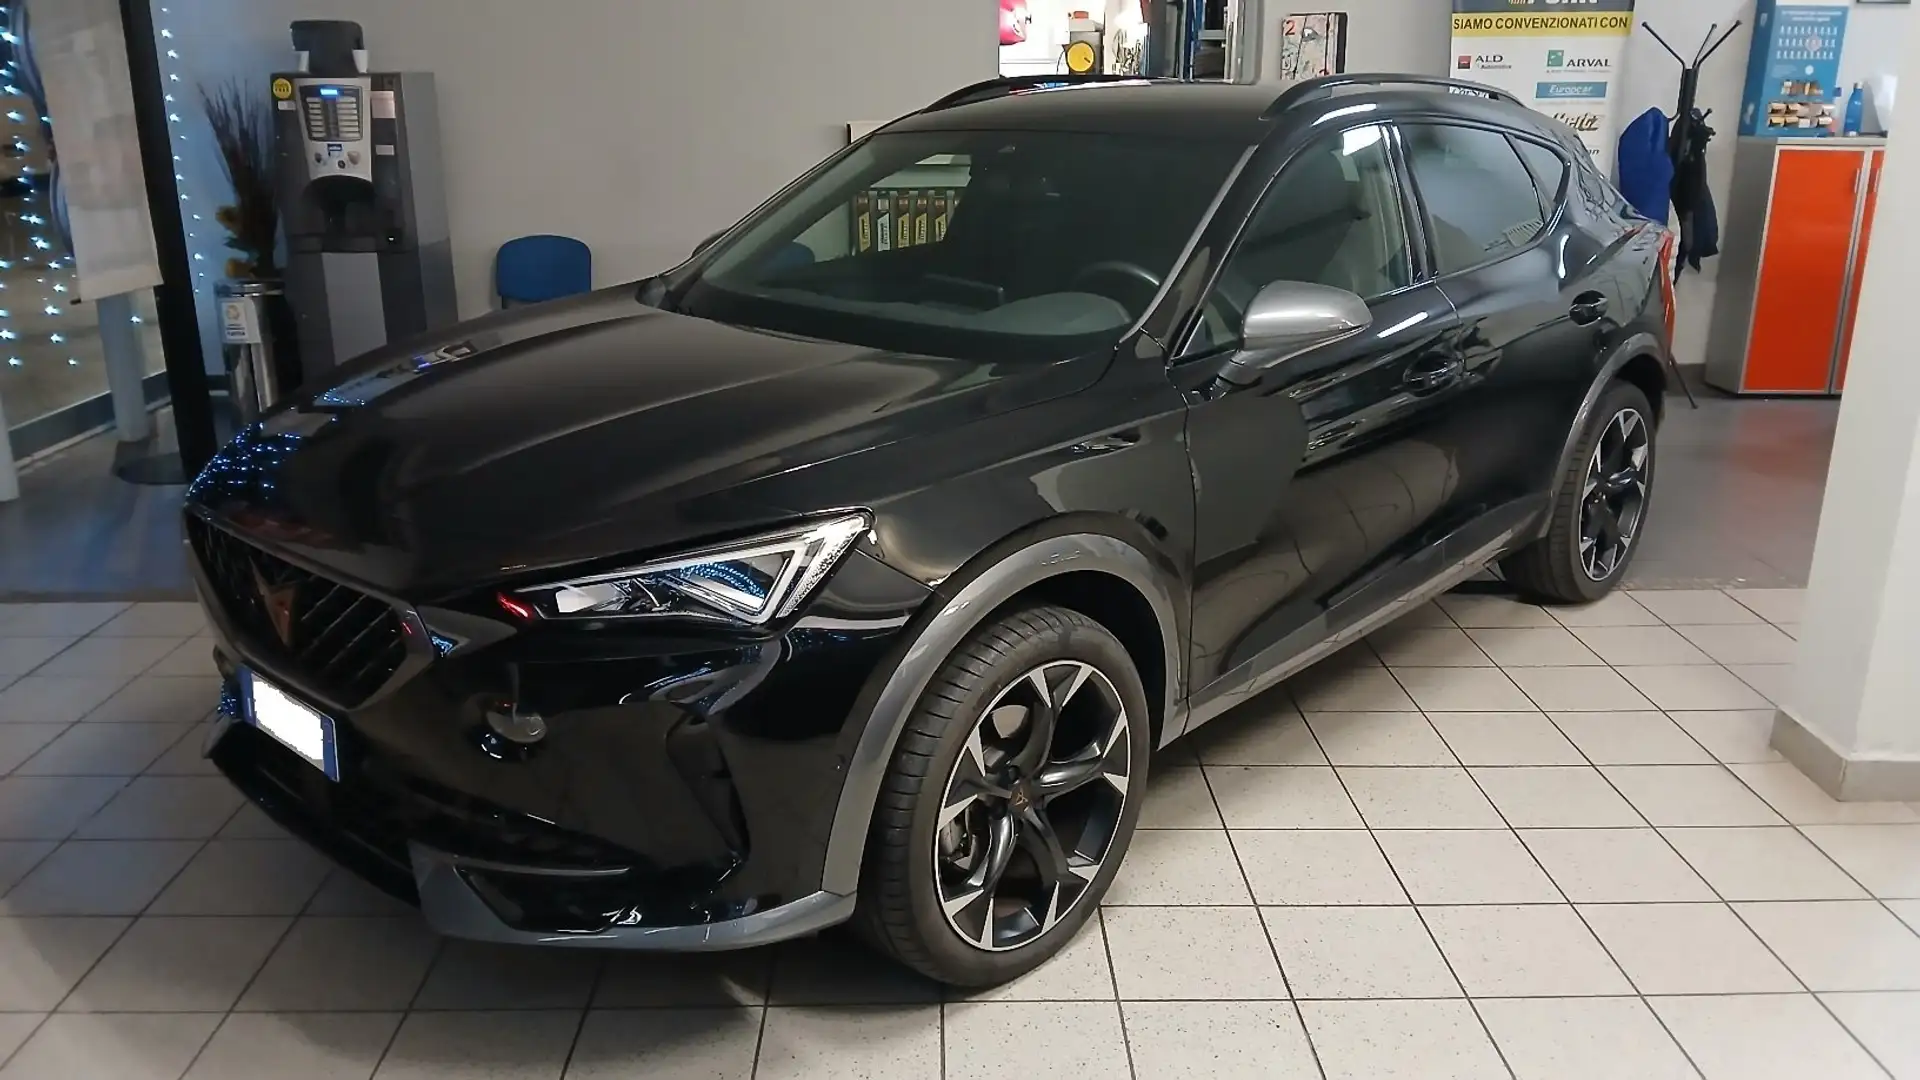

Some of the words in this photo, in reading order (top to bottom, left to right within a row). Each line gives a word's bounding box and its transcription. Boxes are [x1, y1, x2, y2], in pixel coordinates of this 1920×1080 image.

[1453, 18, 1493, 30] SIAMO
[1495, 17, 1598, 30] CONVENZIONATI
[1600, 16, 1628, 29] CON
[1475, 55, 1504, 63] ALD
[1566, 58, 1612, 67] ARVAL
